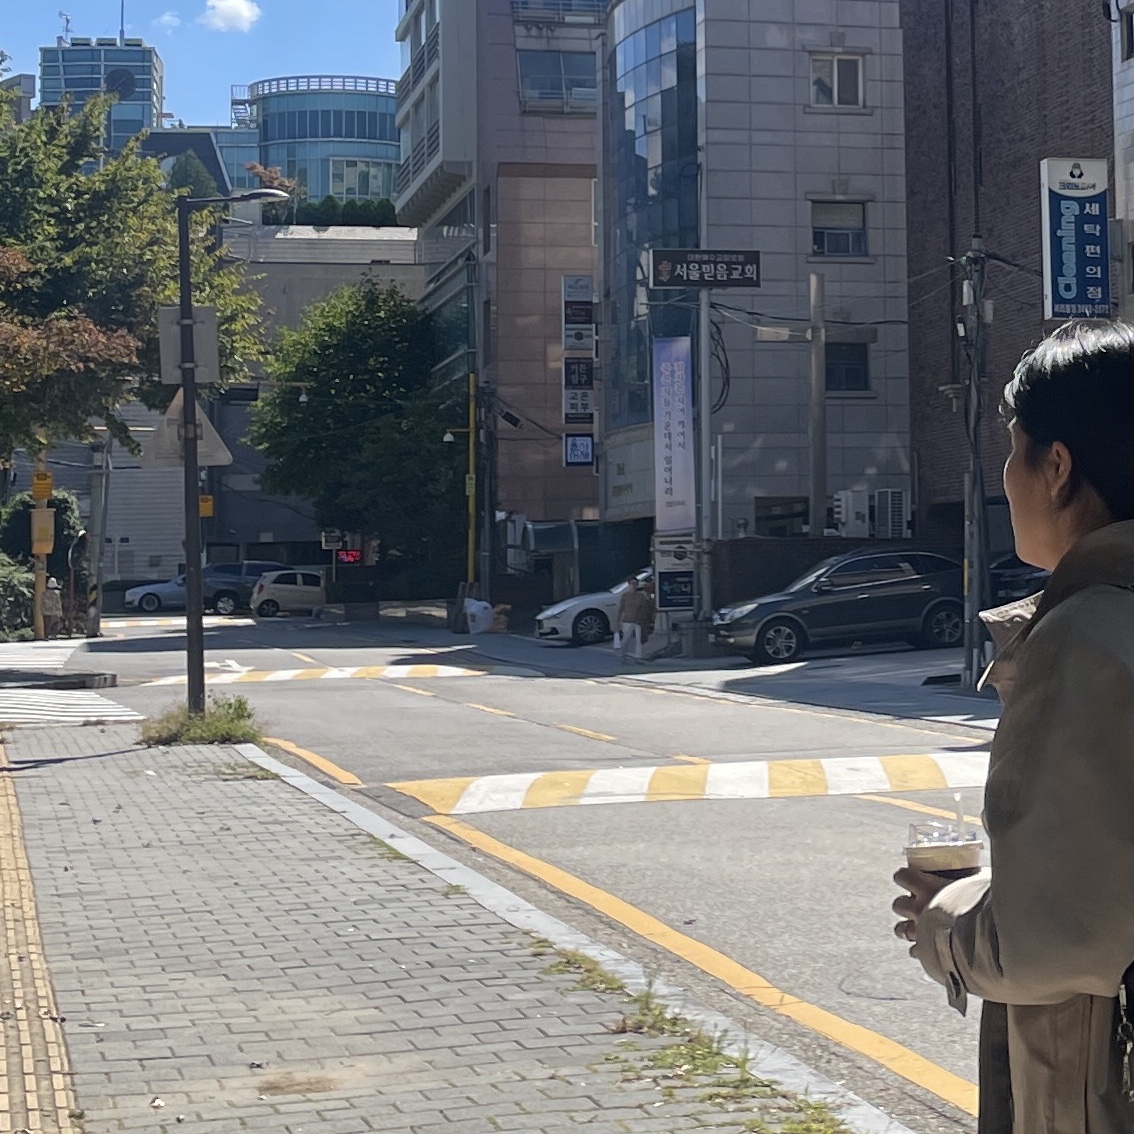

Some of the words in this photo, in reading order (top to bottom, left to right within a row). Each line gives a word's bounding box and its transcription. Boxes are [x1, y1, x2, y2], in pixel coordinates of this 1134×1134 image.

[674, 262, 757, 281] 서울믿음교회
[1056, 200, 1079, 299] Cleaning
[1084, 202, 1102, 299] 세탁편의점
[569, 402, 589, 412] 피부
